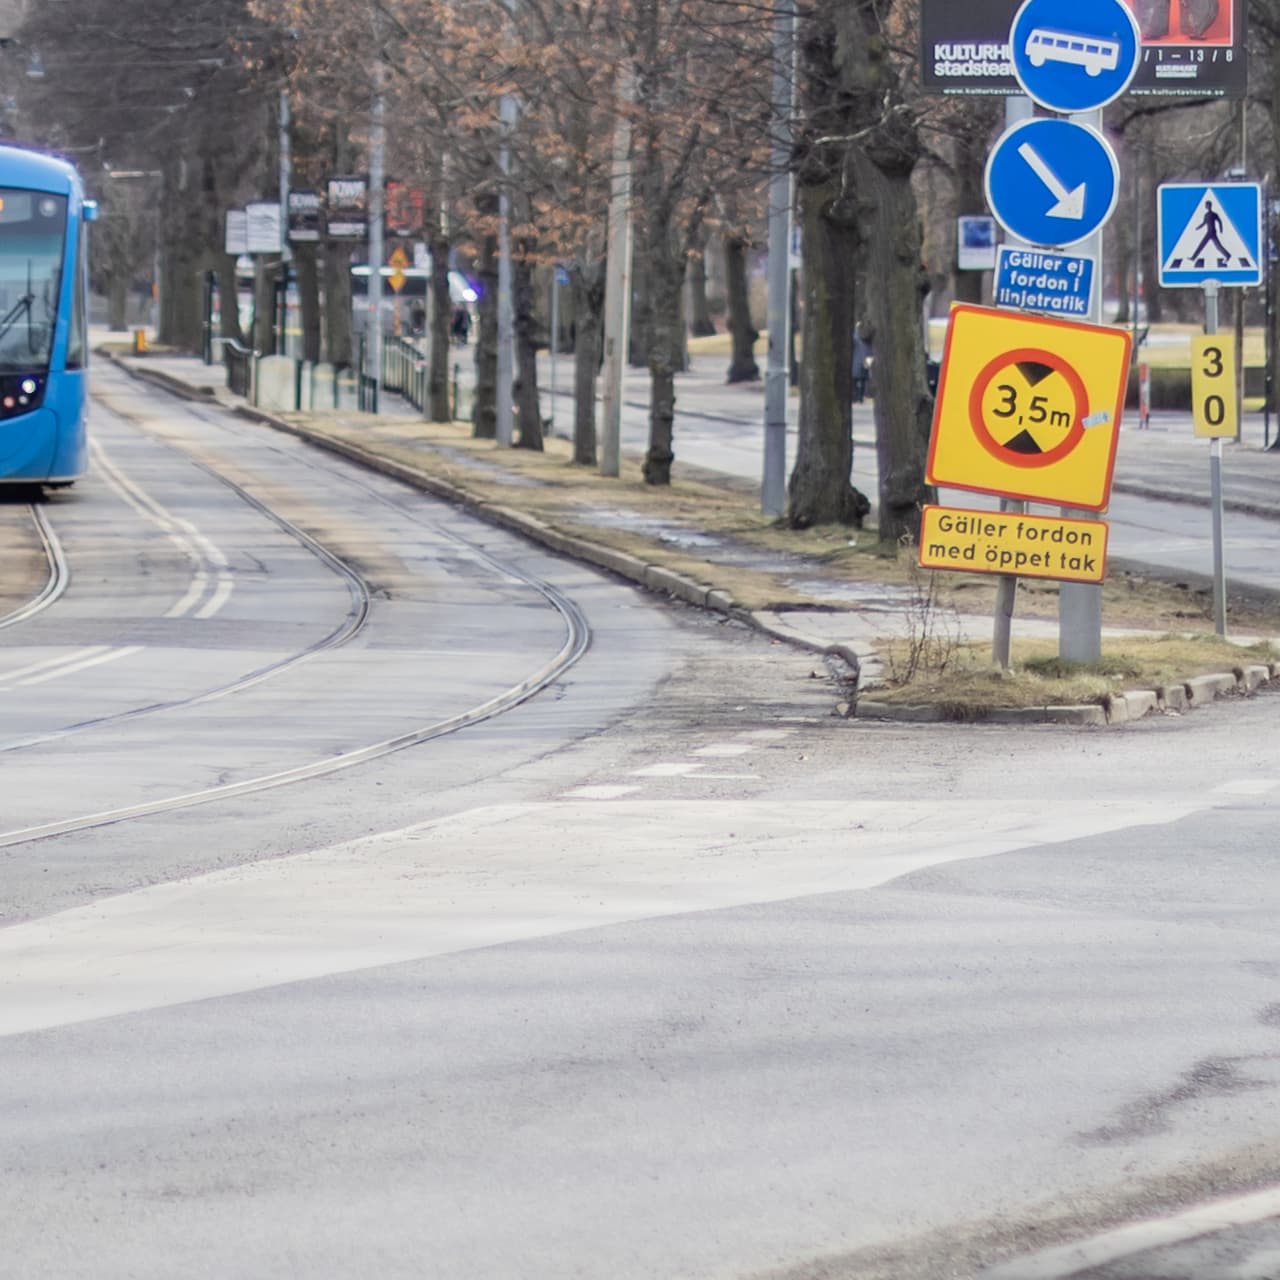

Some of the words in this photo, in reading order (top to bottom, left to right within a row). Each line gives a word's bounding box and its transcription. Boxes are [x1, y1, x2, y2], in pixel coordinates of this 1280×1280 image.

[1009, 252, 1062, 271] Gäller
[1067, 259, 1085, 277] ej
[1010, 270, 1068, 291] fordon
[1073, 276, 1080, 292] i
[999, 287, 1085, 312] linjetrafik
[938, 515, 1008, 538] Gäller
[1017, 522, 1093, 547] fordon
[928, 543, 976, 561] med
[985, 544, 1051, 569] öppet
[1060, 552, 1097, 573] tak
